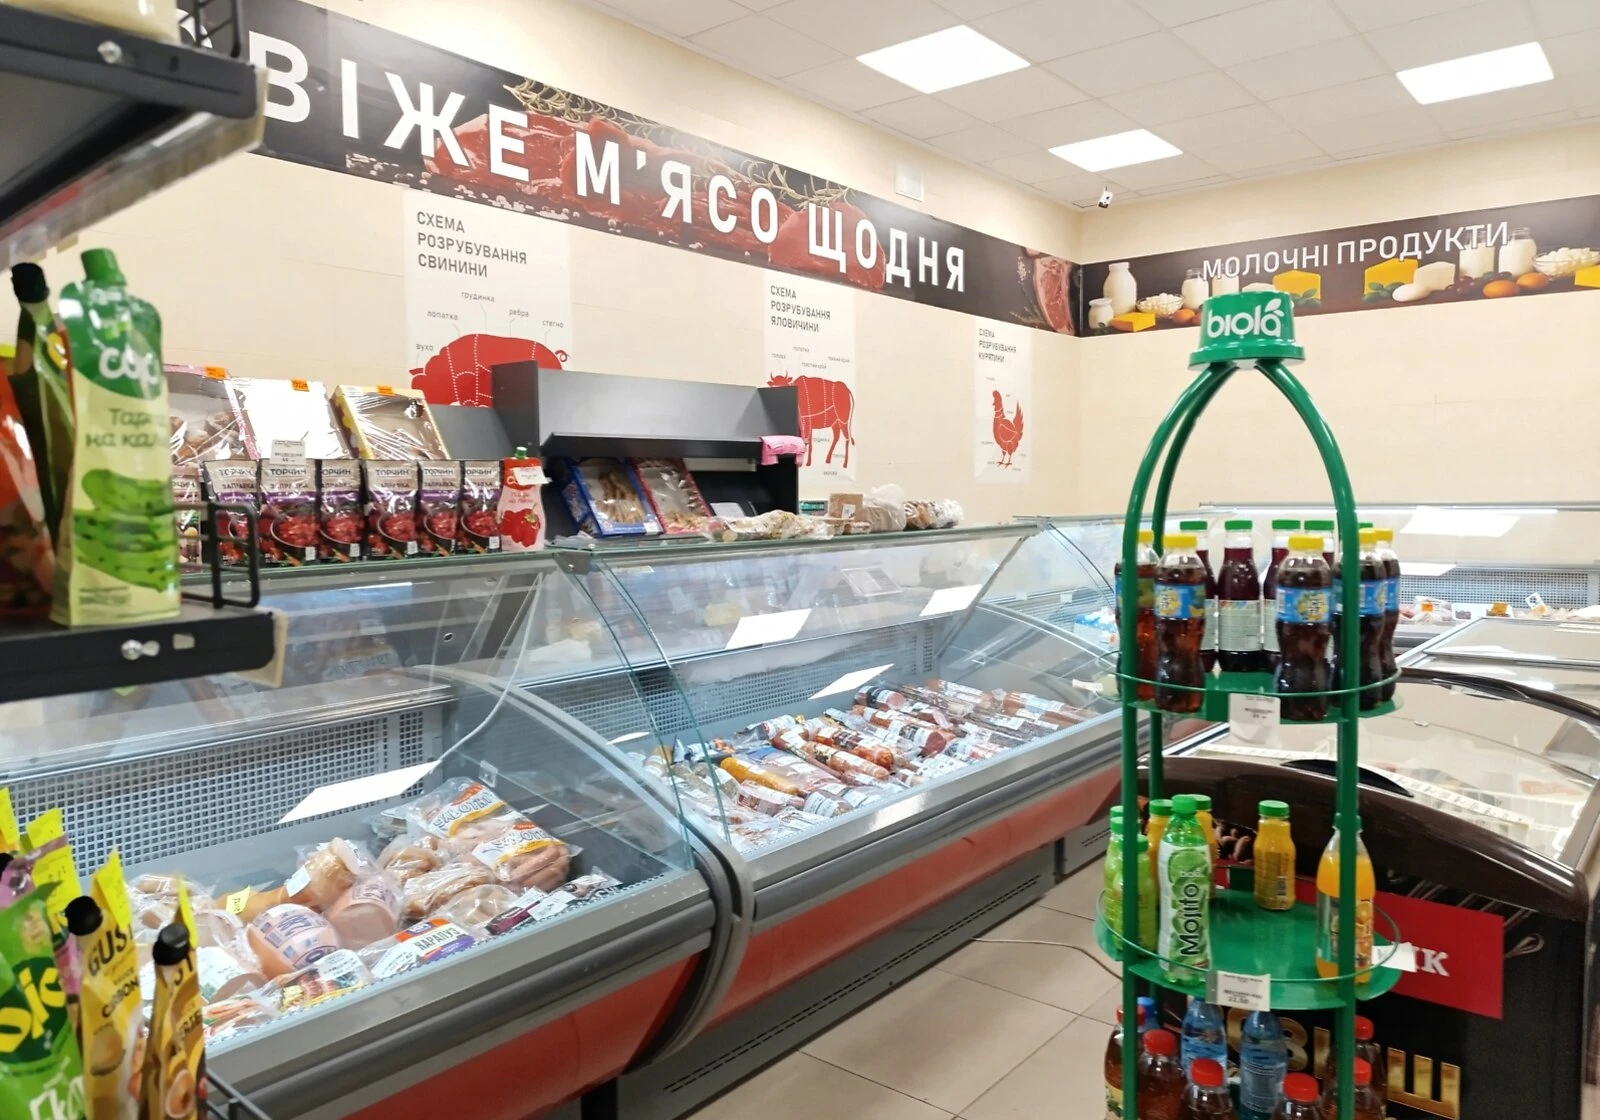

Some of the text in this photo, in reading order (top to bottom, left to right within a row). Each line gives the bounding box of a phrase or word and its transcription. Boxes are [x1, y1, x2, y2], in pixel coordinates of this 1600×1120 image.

[575, 130, 779, 244] М'ЯСО
[807, 201, 965, 293] ЩОДНЯ
[416, 210, 466, 234] СХЕМА
[417, 232, 528, 265] РОЗРУБУВАННЯ
[1202, 220, 1509, 281] МОЛОЧНІ ПРОДУКТИ
[418, 252, 489, 278] СВИНИНИ
[461, 291, 495, 303] грудинка
[770, 284, 798, 300] СХЕМА
[426, 310, 459, 322] лопатка
[770, 299, 832, 321] РОЗРУБУВАННЯ
[541, 319, 564, 329] стегно
[771, 315, 820, 333] ЯЛОВИЧИНИ
[415, 343, 434, 352] вухо
[270, 468, 307, 476] ТОРЧИН
[322, 468, 351, 476] ОРЧИН
[375, 468, 410, 476] ТОРЧИН
[423, 468, 454, 476] ТОРЧИН
[465, 467, 492, 476] ОРЧИН
[1178, 883, 1202, 956] Mojito
[413, 926, 462, 952] КАРАПУЗ
